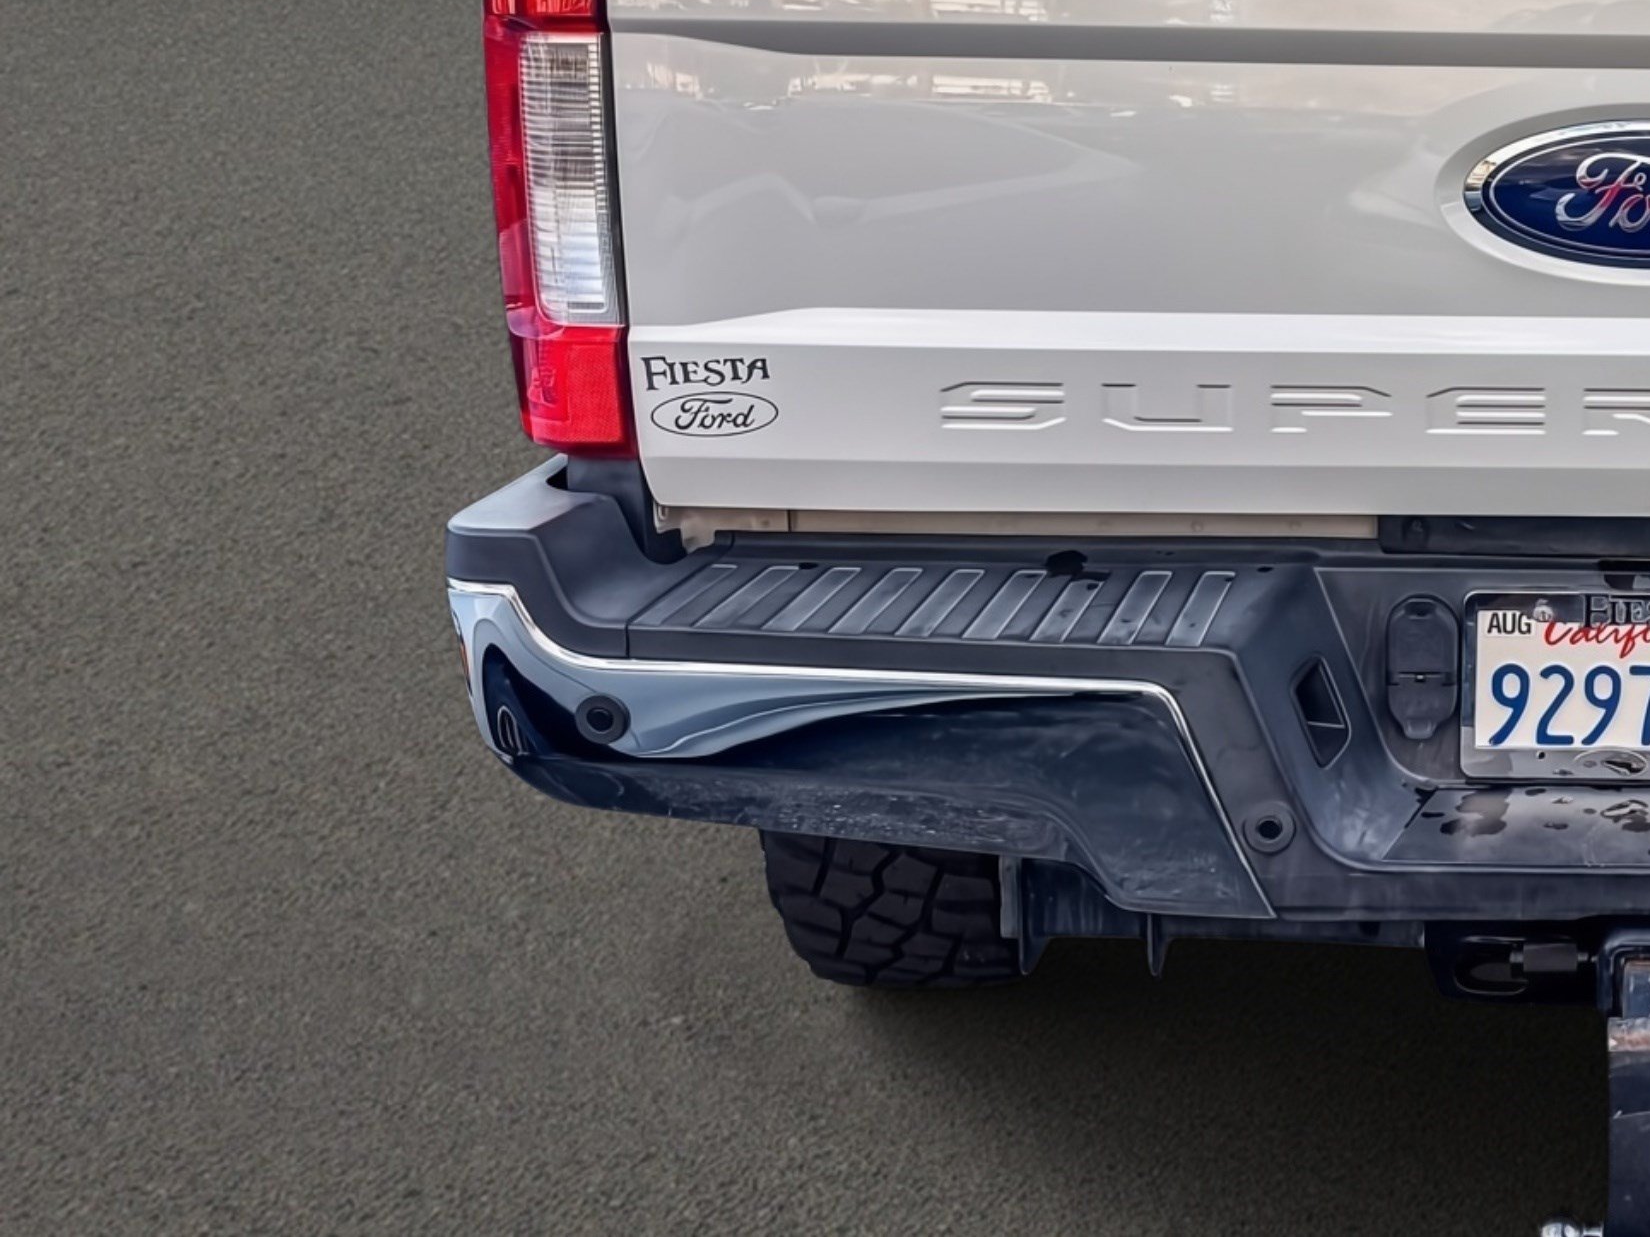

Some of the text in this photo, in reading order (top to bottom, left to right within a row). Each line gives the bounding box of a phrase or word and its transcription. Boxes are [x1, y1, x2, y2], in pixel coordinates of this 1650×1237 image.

[640, 355, 771, 392] FIESTA
[674, 397, 756, 430] Ford
[1486, 612, 1532, 635] AUG
